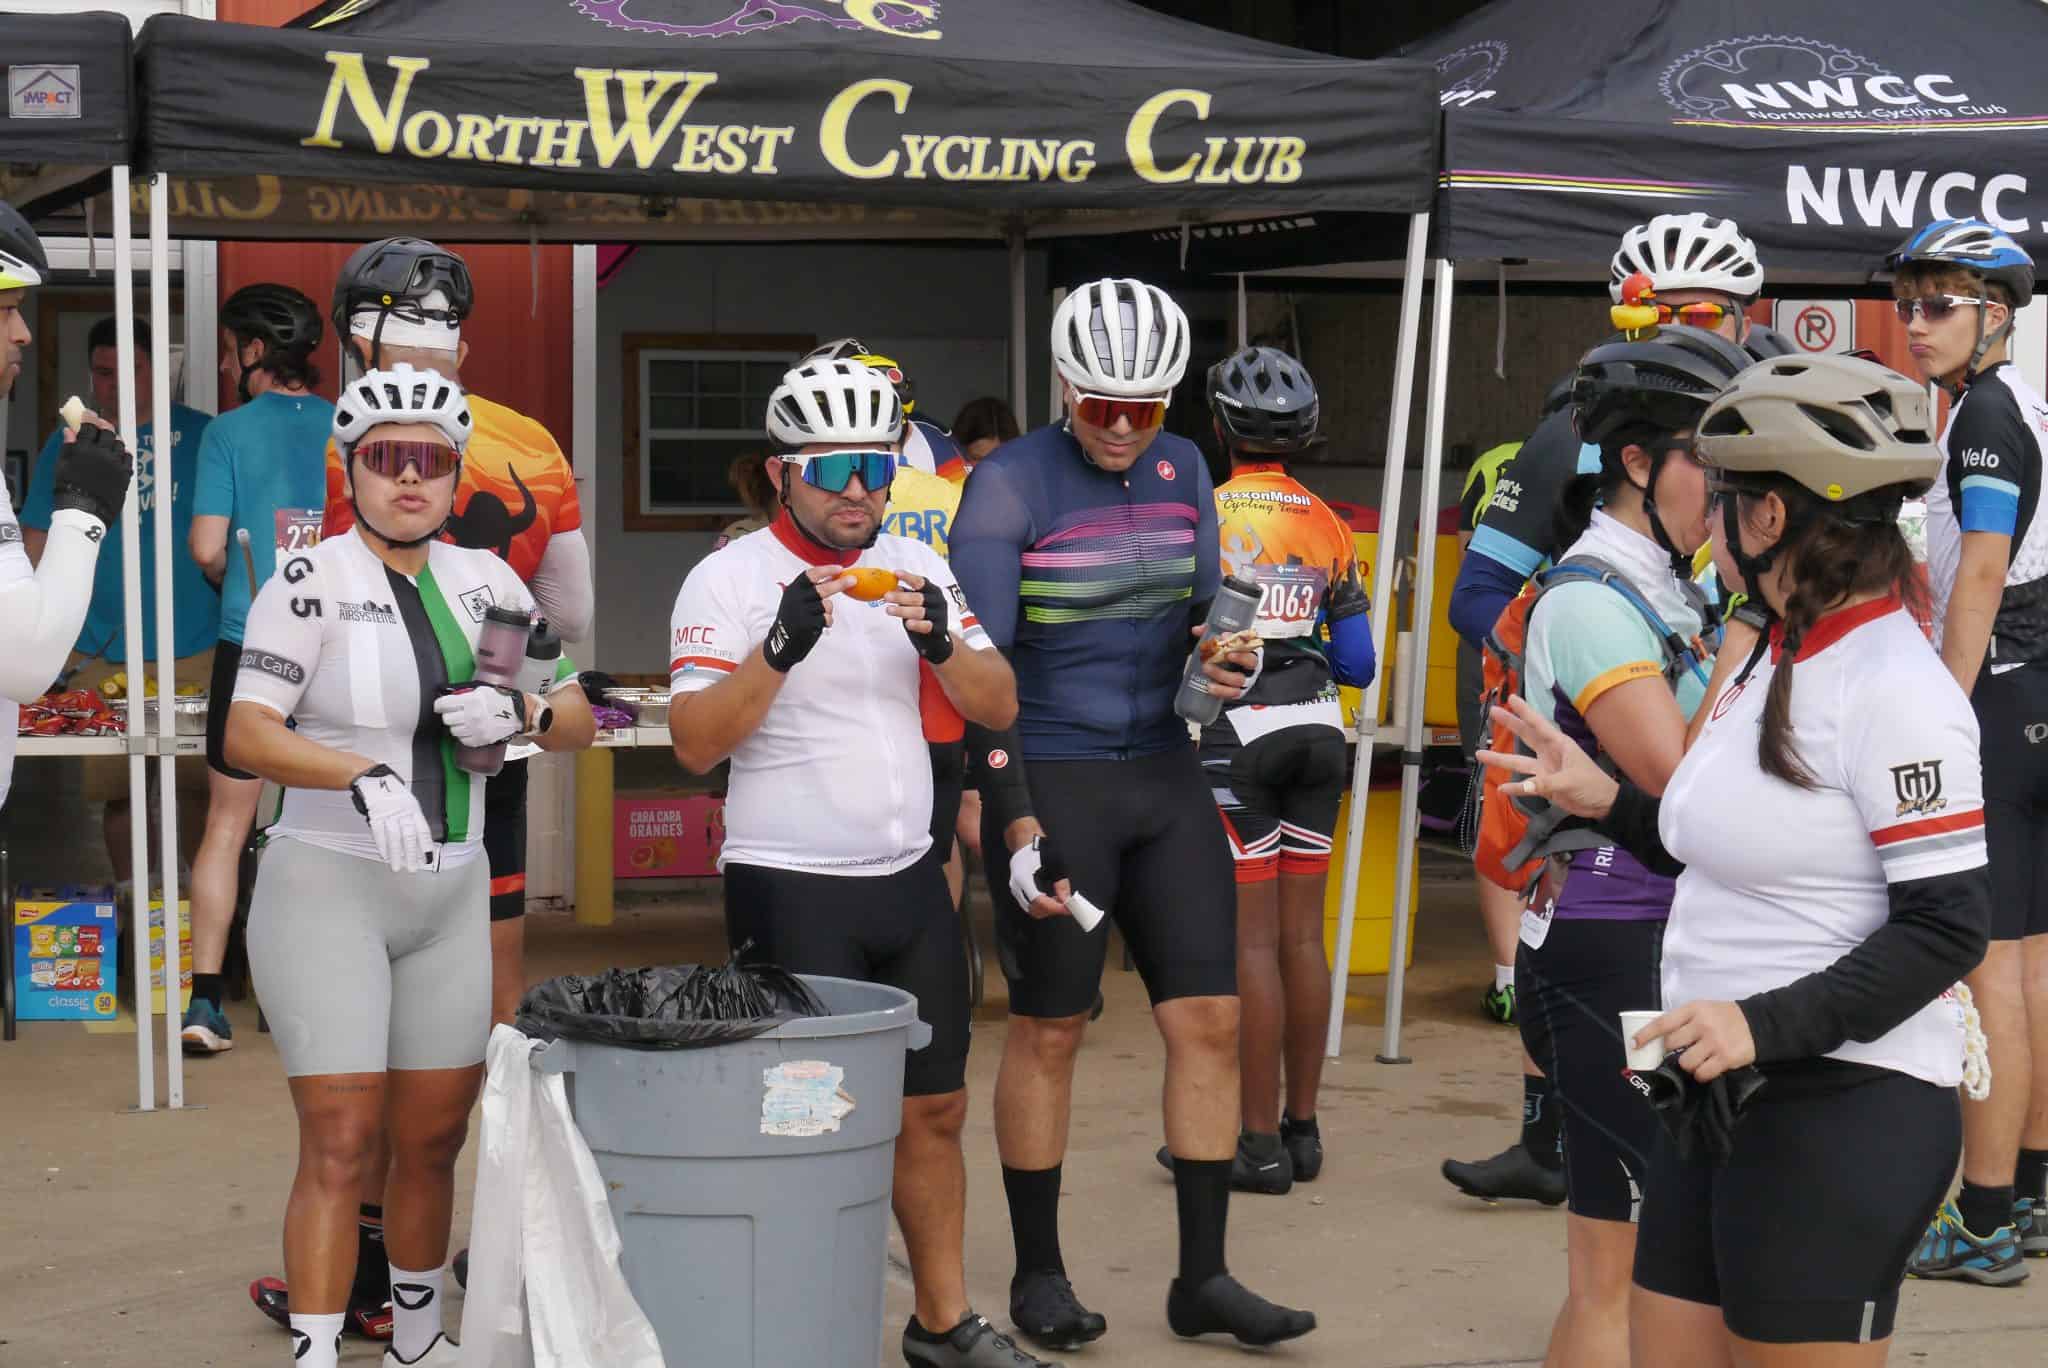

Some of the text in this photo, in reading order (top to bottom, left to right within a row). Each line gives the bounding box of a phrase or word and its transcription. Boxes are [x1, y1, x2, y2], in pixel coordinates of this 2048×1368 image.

[1721, 74, 1969, 110] NWCC
[1747, 105, 2007, 121] Northwest Cycling Club
[819, 78, 1096, 183] CYCLING
[1125, 88, 1307, 184] CLUB
[1962, 448, 1999, 468] Velo
[1219, 491, 1312, 506] ExxonMobil
[1257, 583, 1314, 618] 2063
[675, 626, 715, 646] MCC
[261, 655, 299, 681] Café
[631, 809, 682, 823] CARA CARA
[630, 823, 683, 837] ORANGES
